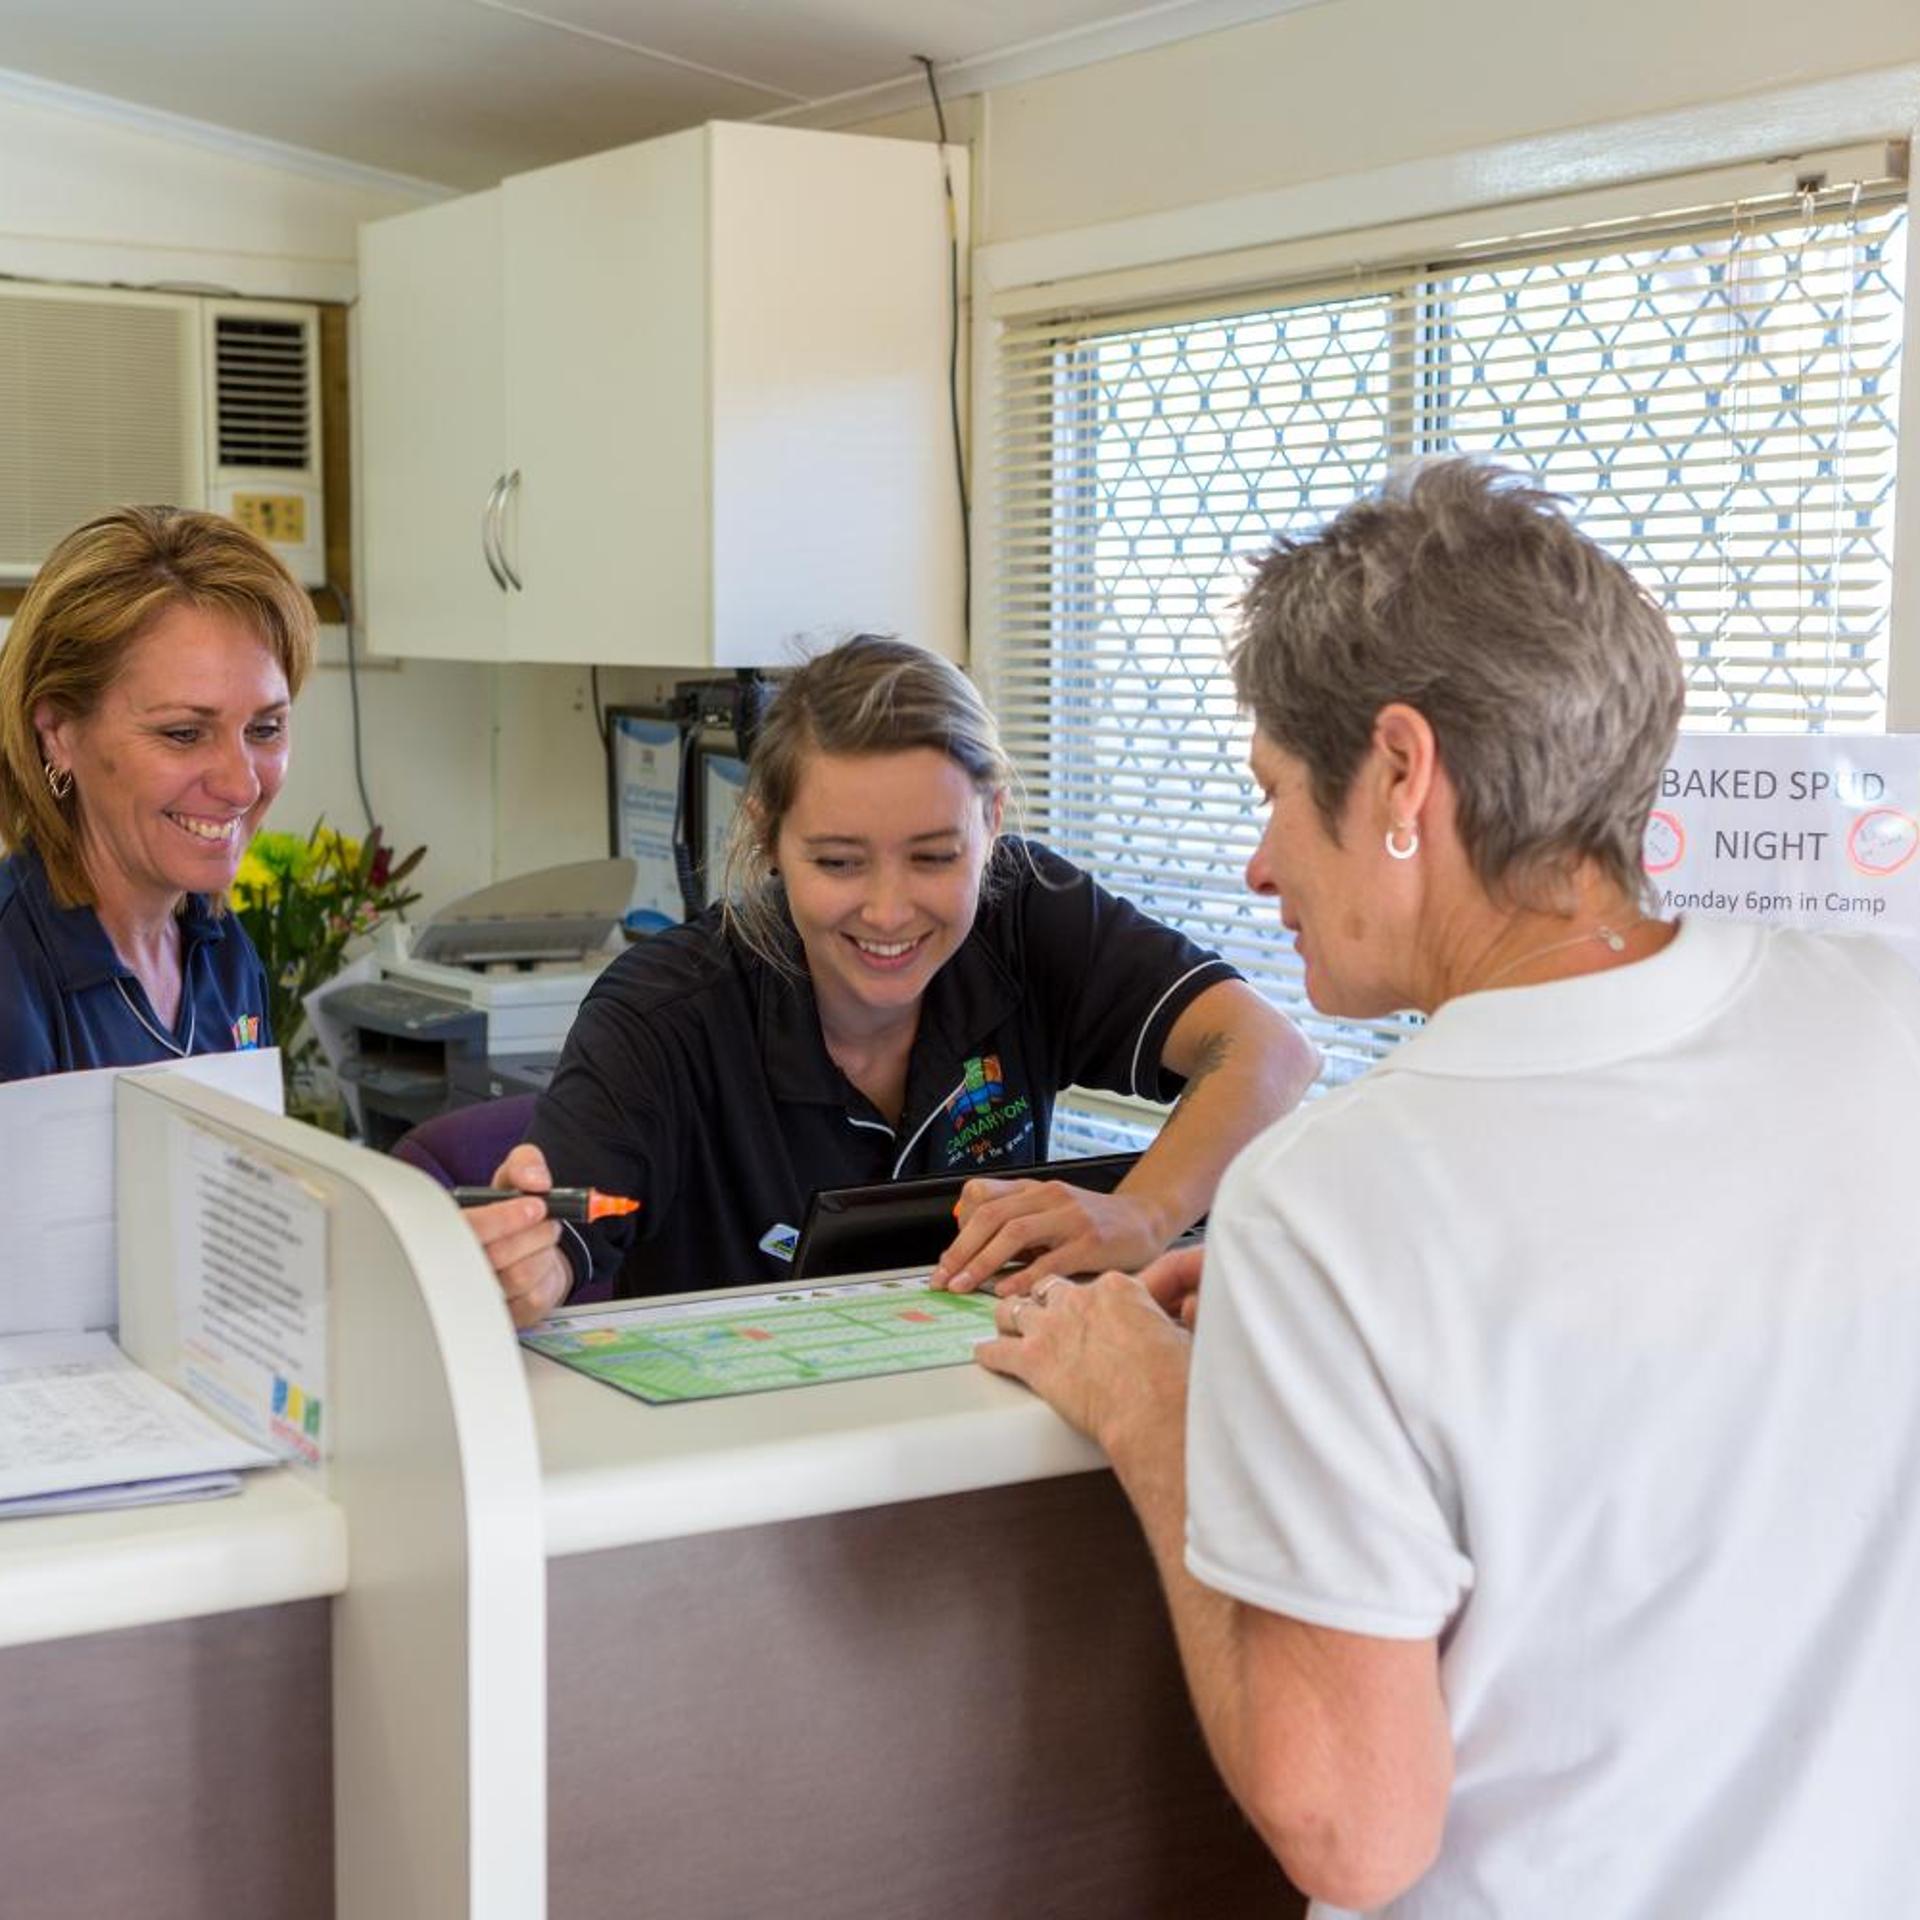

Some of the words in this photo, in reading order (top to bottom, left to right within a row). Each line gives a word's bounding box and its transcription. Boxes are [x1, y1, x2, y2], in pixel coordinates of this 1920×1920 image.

[1661, 769, 1778, 800] BAKED
[1714, 830, 1830, 861] NIGHT
[1745, 890, 1792, 914] 6pm
[1800, 892, 1816, 911] in
[1825, 892, 1886, 916] Camp
